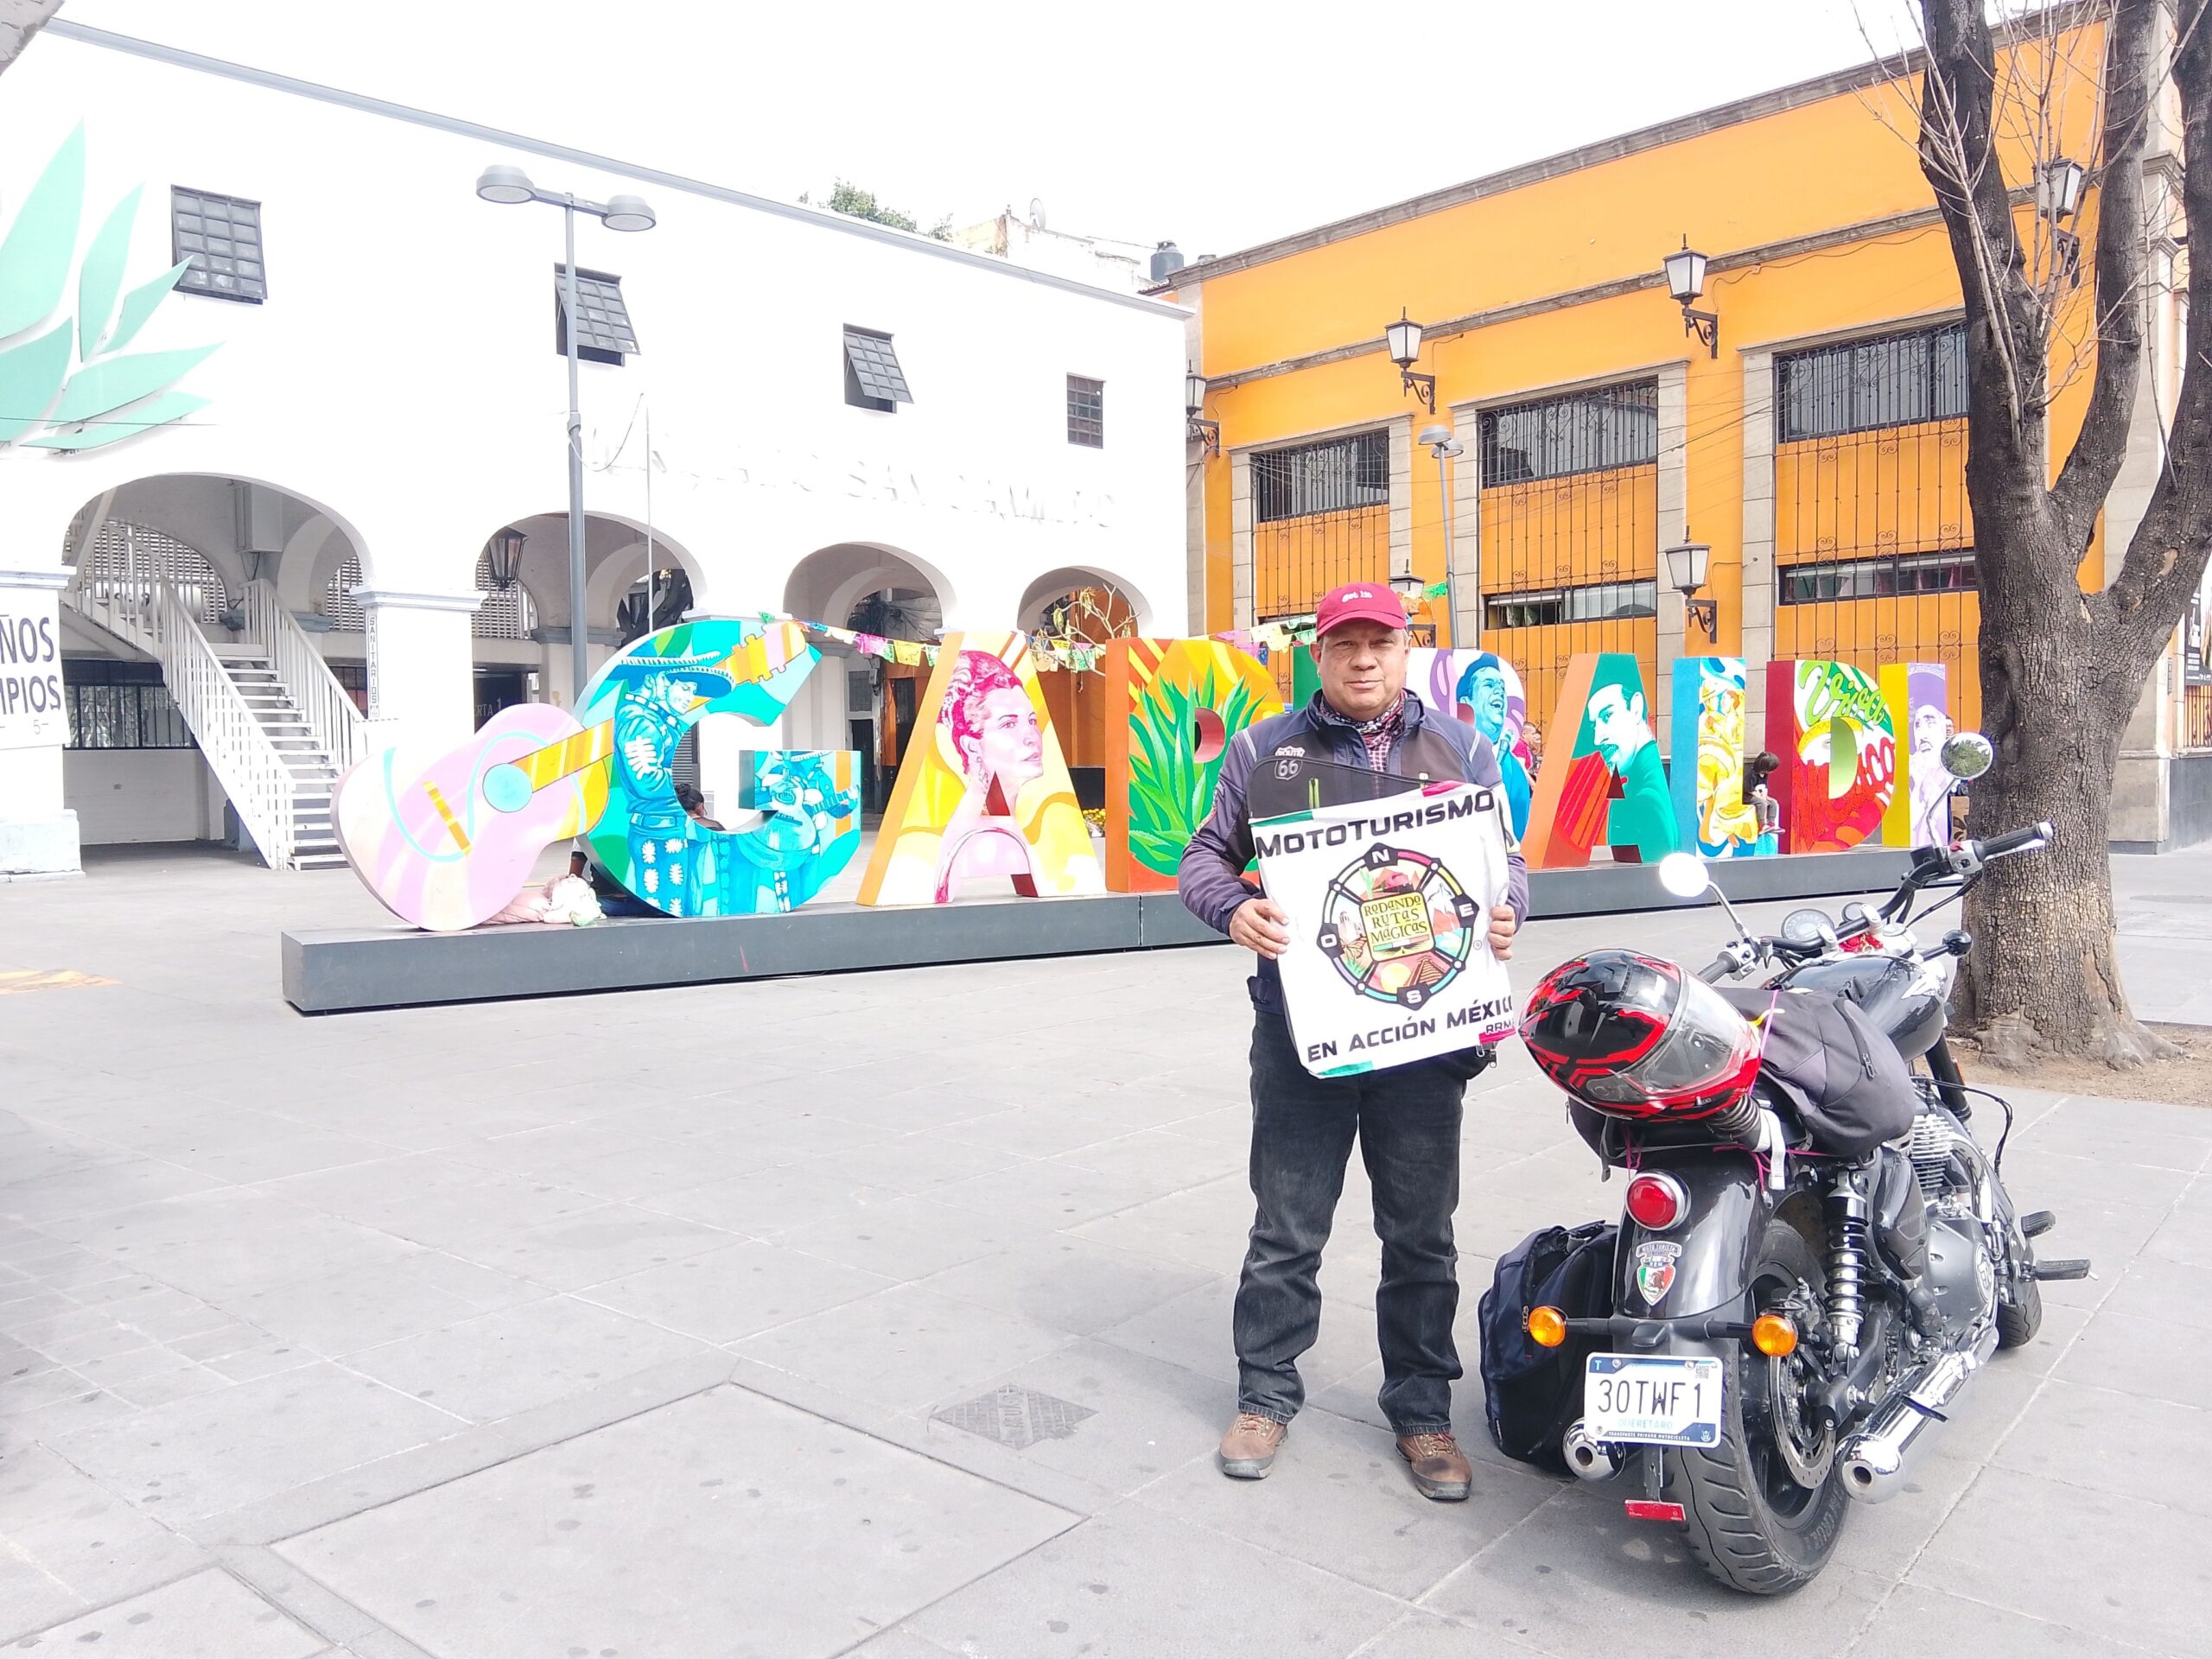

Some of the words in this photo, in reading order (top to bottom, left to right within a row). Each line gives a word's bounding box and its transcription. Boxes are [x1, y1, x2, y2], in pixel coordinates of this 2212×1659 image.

[369, 616, 378, 704] SANITARIOS
[0, 675, 61, 715] PIOS
[1278, 760, 1299, 777] 66
[1255, 790, 1495, 859] MOTOTURISMO
[1371, 849, 1389, 864] N
[1459, 903, 1474, 918] E
[1406, 989, 1422, 1004] S
[1306, 1039, 1338, 1063] EN
[1348, 1016, 1436, 1052] ACCIÓN
